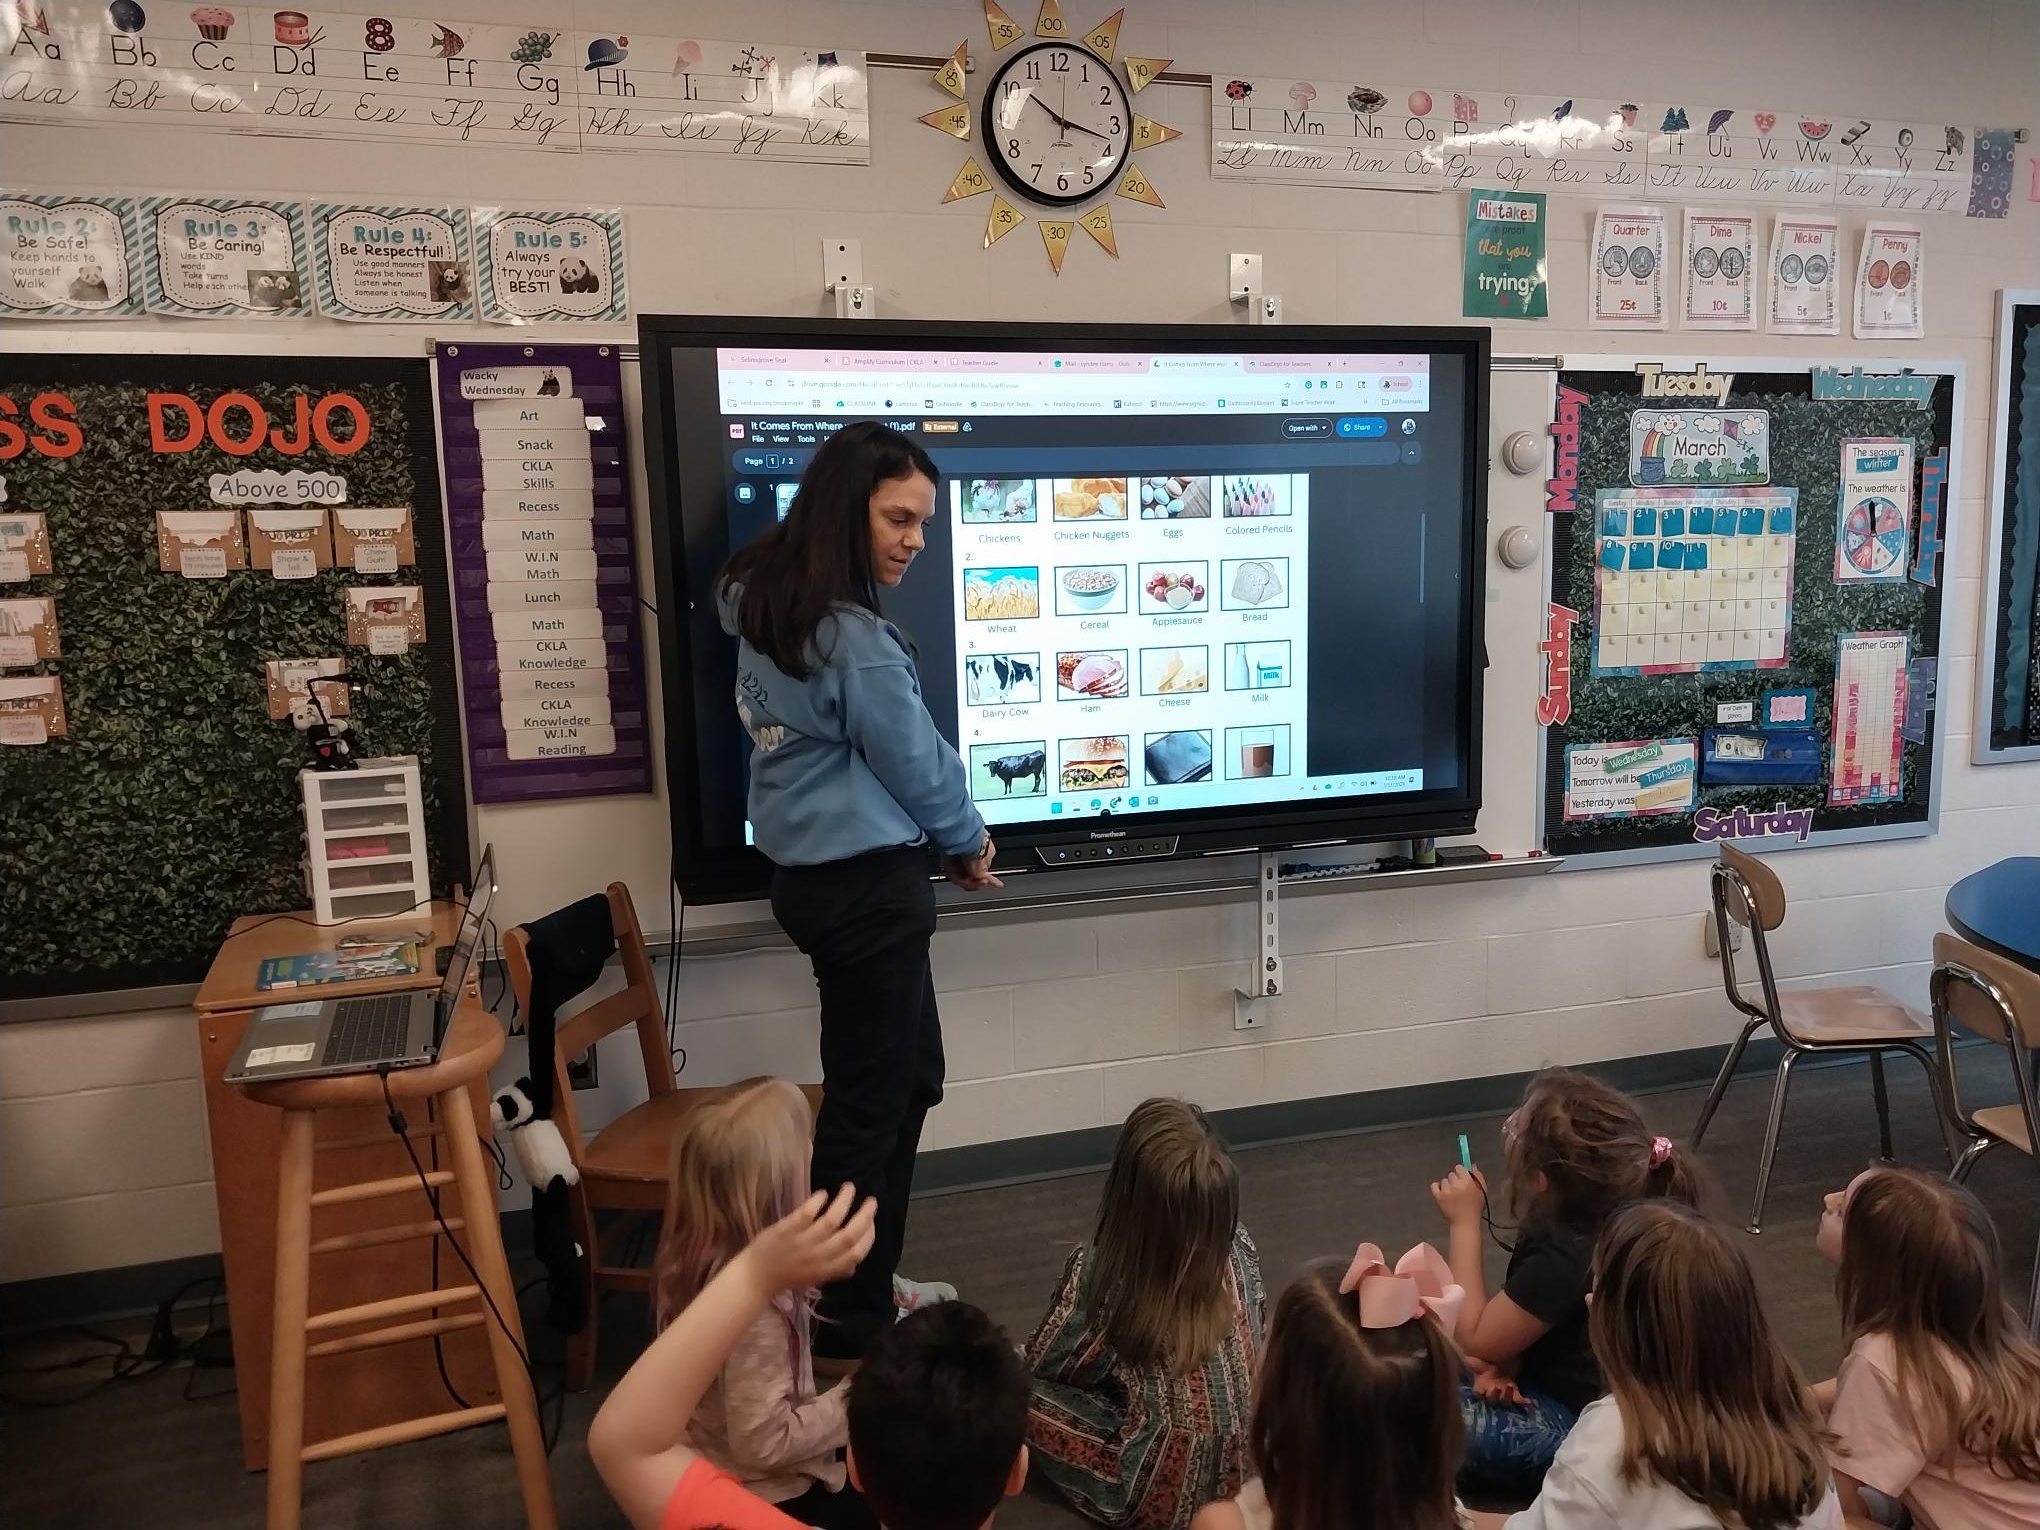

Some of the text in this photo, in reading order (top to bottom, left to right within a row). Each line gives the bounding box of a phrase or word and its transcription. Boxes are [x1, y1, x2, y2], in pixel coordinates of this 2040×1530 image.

[998, 24, 1013, 37] :55
[1040, 18, 1062, 31] :00
[1092, 35, 1109, 49] :05
[1050, 52, 1070, 73] 12
[1026, 60, 1041, 81] 11
[1081, 63, 1089, 83] 1
[1003, 81, 1020, 100] 10
[1099, 85, 1112, 106] 2
[1109, 116, 1121, 135] 3
[1136, 126, 1149, 139] :15
[1008, 139, 1021, 159] 8
[1102, 143, 1112, 158] 4
[962, 173, 983, 187] :40
[1030, 164, 1043, 184] 7
[1083, 165, 1094, 185] 5
[1057, 174, 1068, 191] 6
[1478, 202, 1535, 221] Mistakes
[7, 215, 67, 235] Rule
[184, 219, 267, 237] Rule 3:
[1090, 216, 1107, 229] :25
[353, 226, 432, 244] Rule 4:
[1047, 226, 1066, 240] :30
[1613, 224, 1650, 236] Quarter
[1710, 226, 1732, 237] Dime
[17, 236, 88, 249] Be Safe!
[515, 231, 588, 248] Rule 5:
[1794, 232, 1822, 244] Nickel
[188, 237, 265, 255] Be Caring!
[340, 243, 444, 259] Be Respectful!
[1478, 238, 1532, 262] that you
[1882, 239, 1908, 253] Penny
[10, 252, 96, 264] Keep hands to
[505, 250, 550, 265] Always
[353, 260, 368, 268] Use
[370, 261, 389, 270] good
[10, 265, 62, 283] yourself
[354, 269, 423, 279] Always be honest
[501, 266, 555, 280] try your
[13, 278, 46, 289] Walk
[354, 279, 379, 287] Listen
[510, 281, 550, 294] BEST!
[391, 289, 398, 297] is
[400, 288, 427, 299] talking
[1620, 300, 1637, 311] 25¢
[1712, 300, 1728, 311] 10¢
[463, 371, 498, 382] Wacky
[1636, 363, 1735, 407] Tuesday
[464, 386, 526, 397] Wednesday
[519, 411, 539, 421] Art
[147, 392, 370, 456] DOJO
[751, 422, 915, 432] It Comes From Where (1).pdf
[1288, 424, 1318, 433] Open with
[1353, 423, 1371, 431] Share
[517, 440, 553, 451] Snack
[1547, 384, 1590, 512] Monday
[1674, 437, 1726, 457] March
[1853, 448, 1905, 457] The season is
[522, 461, 554, 472] CKLA
[745, 458, 763, 466] Page
[1864, 459, 1892, 469] winter
[218, 479, 340, 498] Above 500
[523, 478, 554, 489] Skills
[1849, 484, 1906, 493] The weather is
[518, 502, 560, 512] Recess
[521, 530, 555, 541] Math
[1054, 529, 1130, 541] Chicken Nuggets
[1163, 528, 1184, 539] Eggs
[1225, 524, 1293, 535] Colored Pencils
[978, 533, 1021, 544] Chickens
[525, 552, 559, 563] W.I.N
[526, 569, 560, 580] Math
[525, 592, 561, 603] Lunch
[1152, 616, 1203, 627] Applesauce
[1242, 613, 1268, 622] Bread
[532, 620, 565, 631] Math
[987, 624, 1016, 634] Wheat
[1080, 620, 1110, 630] Cereal
[536, 641, 568, 652] CKLA
[1845, 640, 1903, 650] Weather Graph
[519, 657, 587, 669] Knowledge
[1537, 602, 1580, 726] Sunday
[1263, 671, 1280, 680] Milk
[535, 679, 576, 690] Recess
[1158, 697, 1191, 708] Cheese
[1251, 693, 1269, 703] Milk
[541, 700, 572, 711] CKLA
[1080, 704, 1101, 713] Ham
[982, 707, 1029, 719] Dairy Cow
[523, 716, 591, 728] Knowledge
[544, 728, 577, 739] W.I.N
[538, 745, 587, 756] Reading
[1572, 756, 1599, 767] Today
[1609, 746, 1658, 769] Wednesday
[1572, 762, 1687, 787] Tomorrow will be Thursday
[1572, 797, 1634, 809] Yesterday was
[1693, 802, 1814, 842] Saturday
[1090, 831, 1126, 839] Promethean
